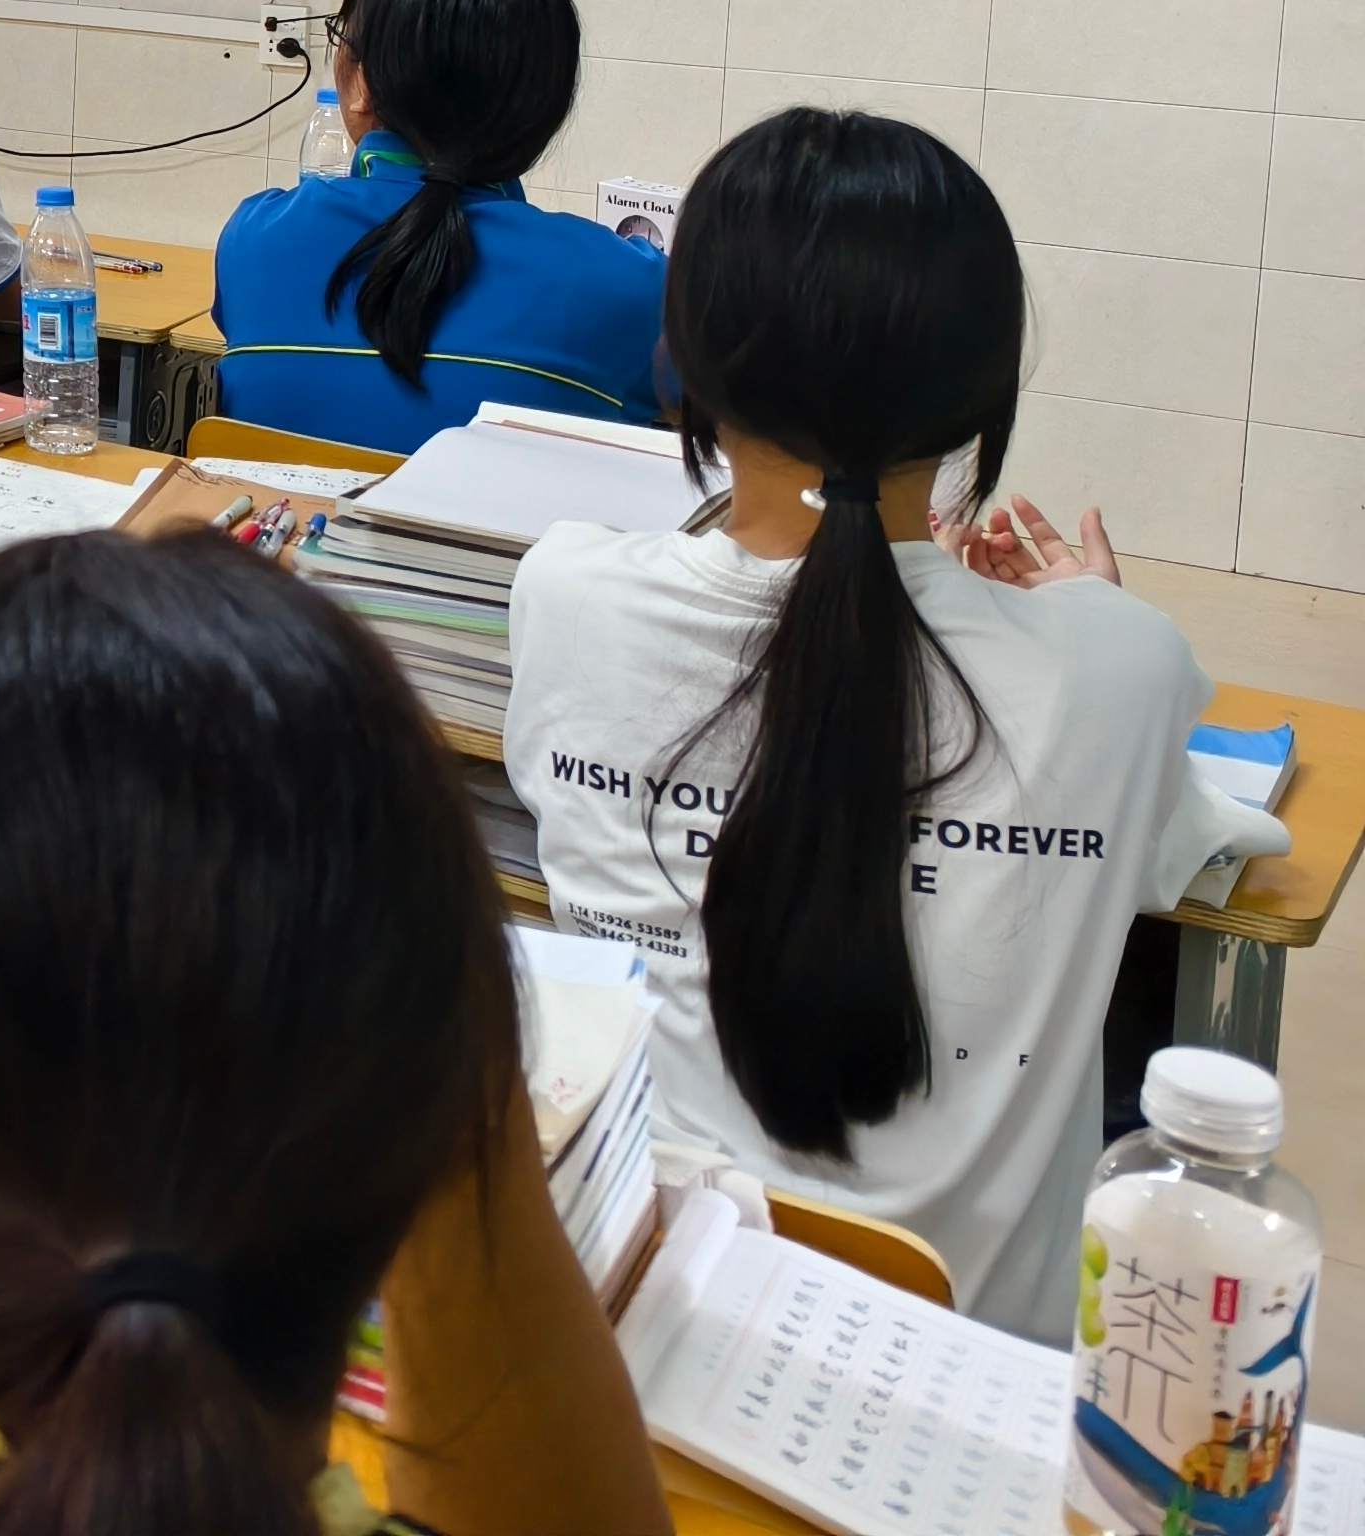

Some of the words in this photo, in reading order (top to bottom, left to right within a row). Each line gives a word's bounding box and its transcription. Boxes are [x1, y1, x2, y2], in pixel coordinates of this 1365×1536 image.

[605, 194, 640, 209] Alarm
[643, 200, 675, 215] Clock
[551, 751, 631, 798] WISH
[909, 814, 1106, 860] FOREVER
[593, 911, 632, 930] 15926
[637, 922, 681, 941] 53589
[956, 1048, 968, 1060] D
[1018, 1055, 1029, 1067] F
